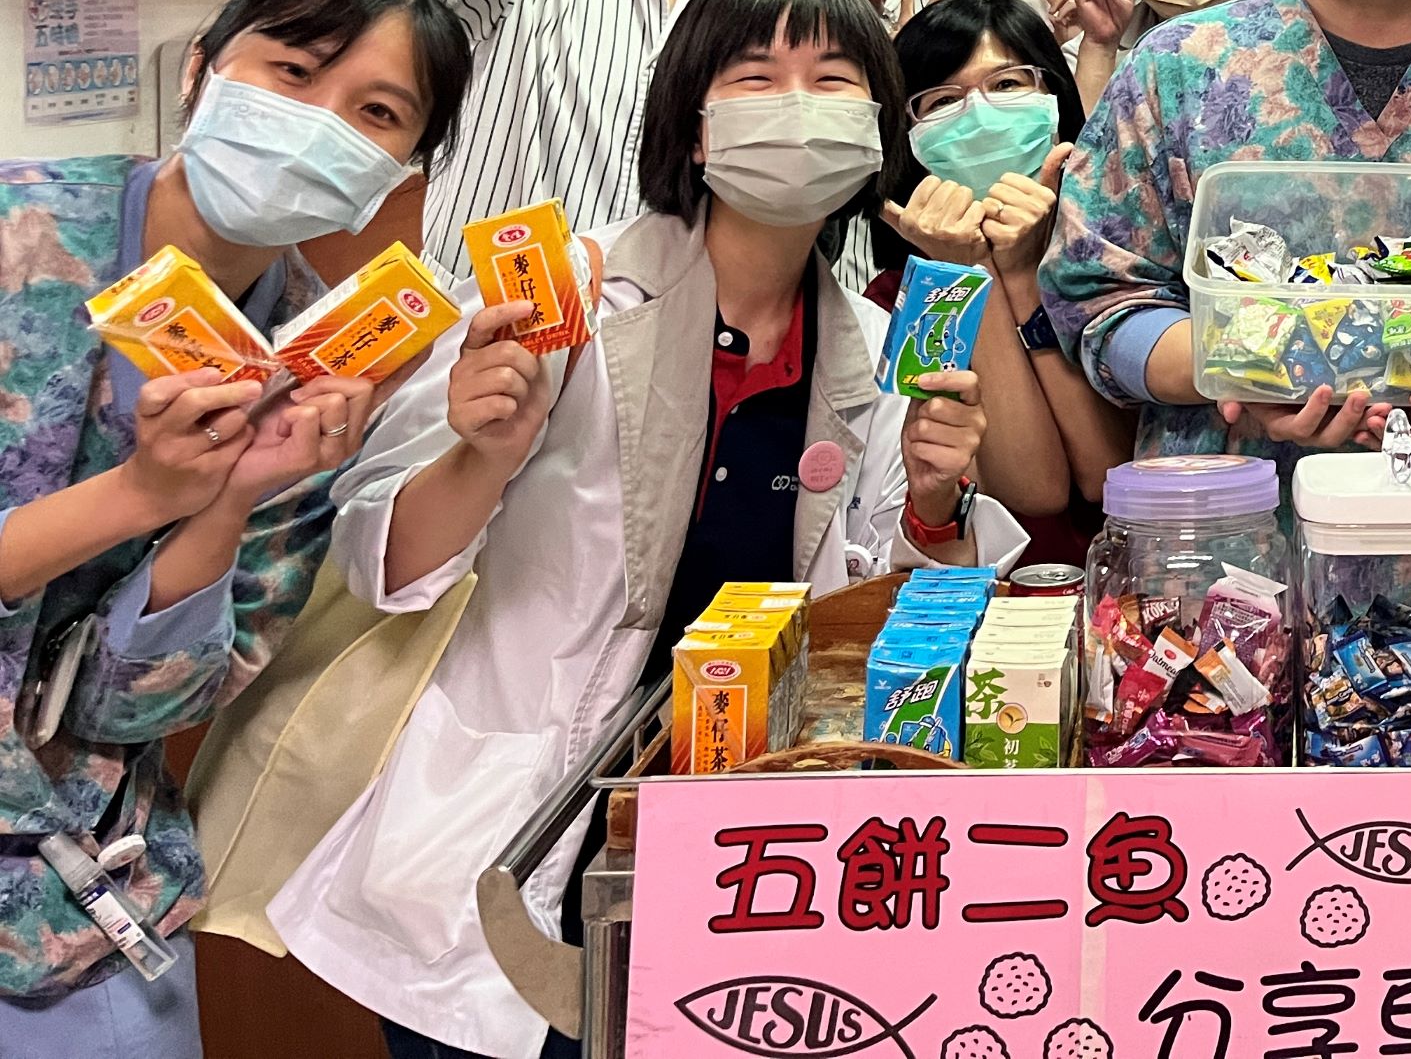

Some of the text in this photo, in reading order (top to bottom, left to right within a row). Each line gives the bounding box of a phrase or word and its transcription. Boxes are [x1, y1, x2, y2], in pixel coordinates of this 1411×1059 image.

[513, 253, 545, 326] 麥仔茶
[923, 286, 972, 303] 舒跑
[328, 313, 400, 371] 麥仔茶
[884, 679, 939, 711] 舒跑
[966, 667, 1009, 720] 茶
[711, 690, 730, 771] 麥仔茶
[709, 810, 1189, 933] 五餅二魚
[707, 985, 864, 1049] JESUS
